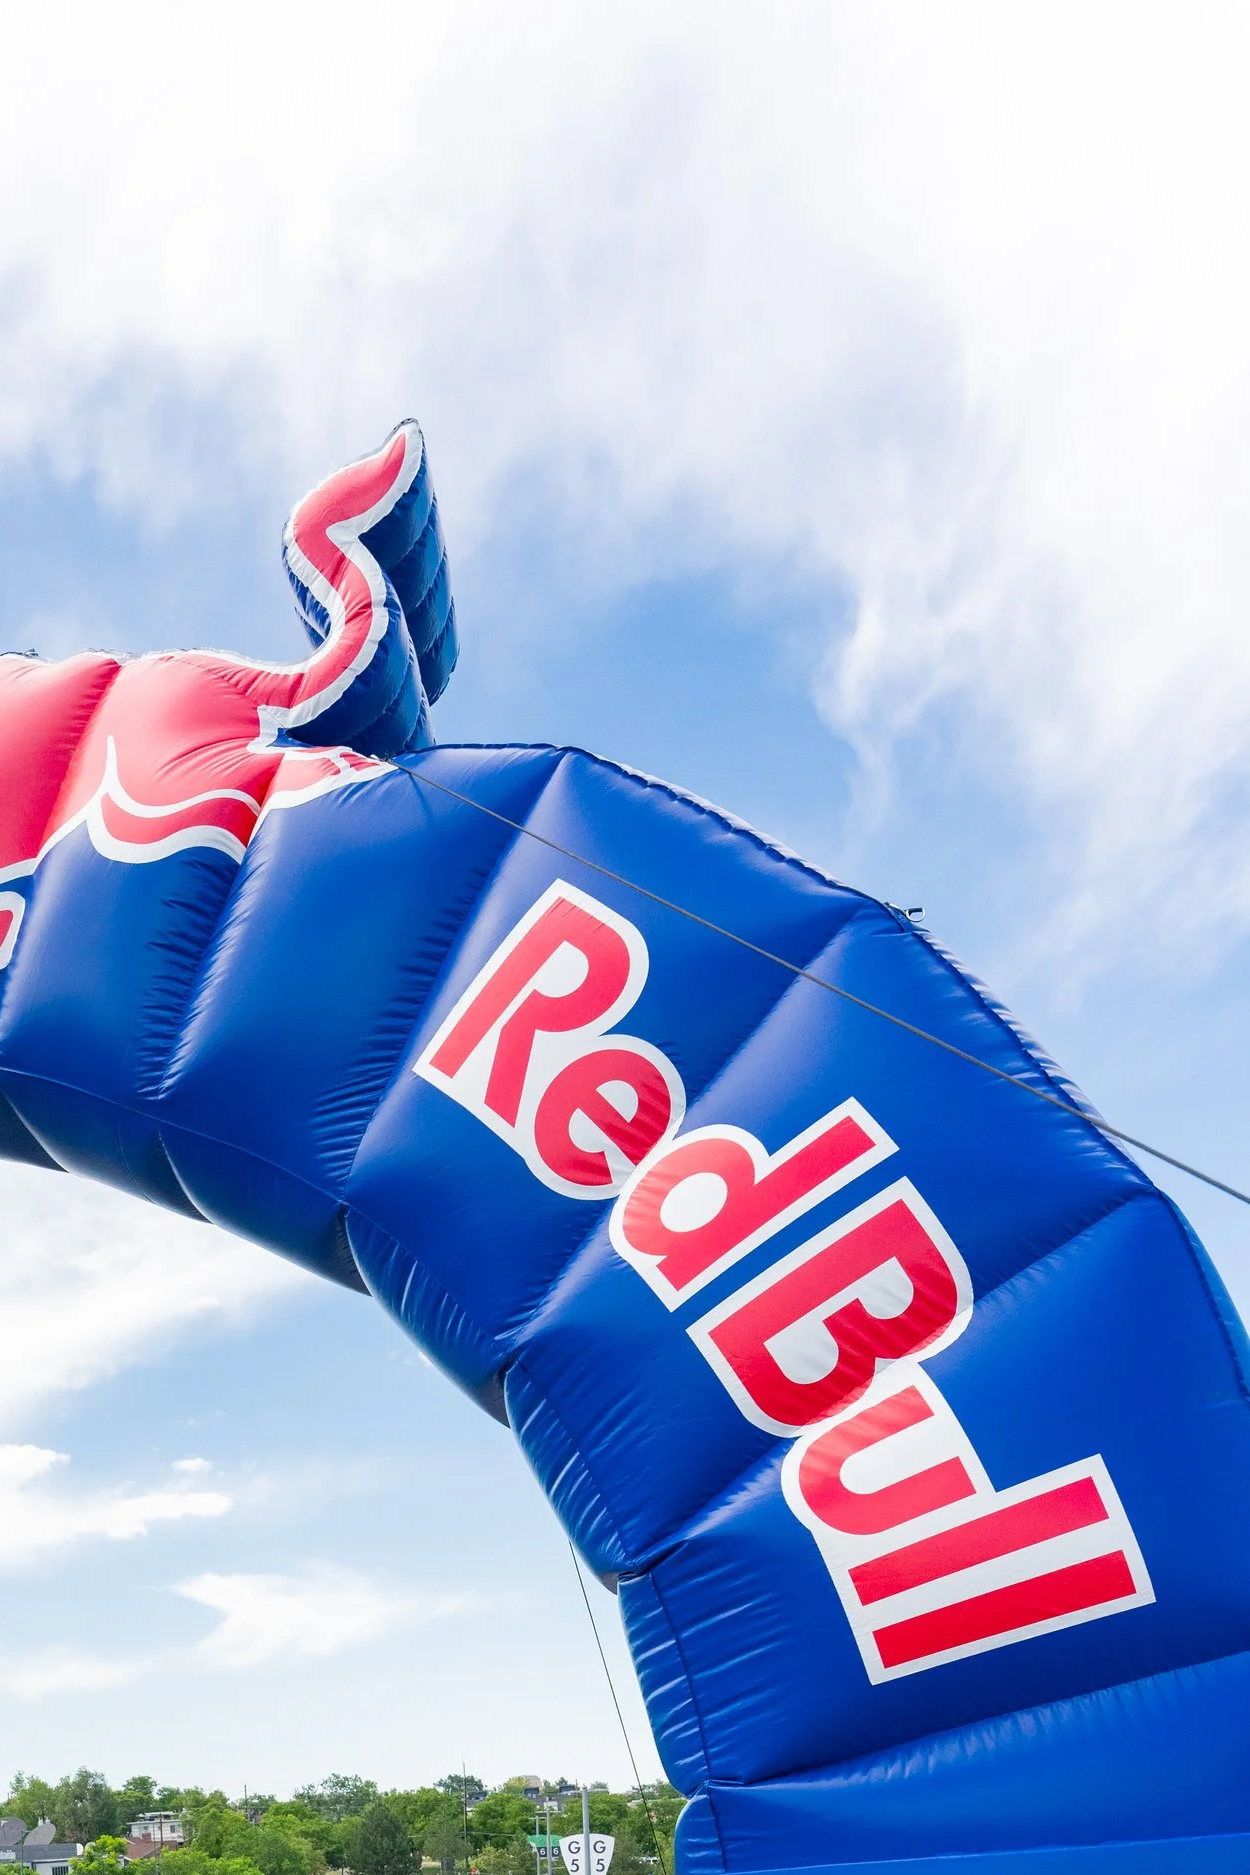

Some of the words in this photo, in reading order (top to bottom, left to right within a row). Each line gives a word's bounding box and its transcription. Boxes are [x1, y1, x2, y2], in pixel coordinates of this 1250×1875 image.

[420, 886, 888, 1302] Red
[694, 1184, 1149, 1679] Bull
[540, 1848, 546, 1856] 6
[553, 1847, 559, 1855] 6
[568, 1841, 581, 1854] G
[593, 1840, 607, 1854] G
[570, 1859, 580, 1872] 5
[595, 1859, 605, 1872] 5
